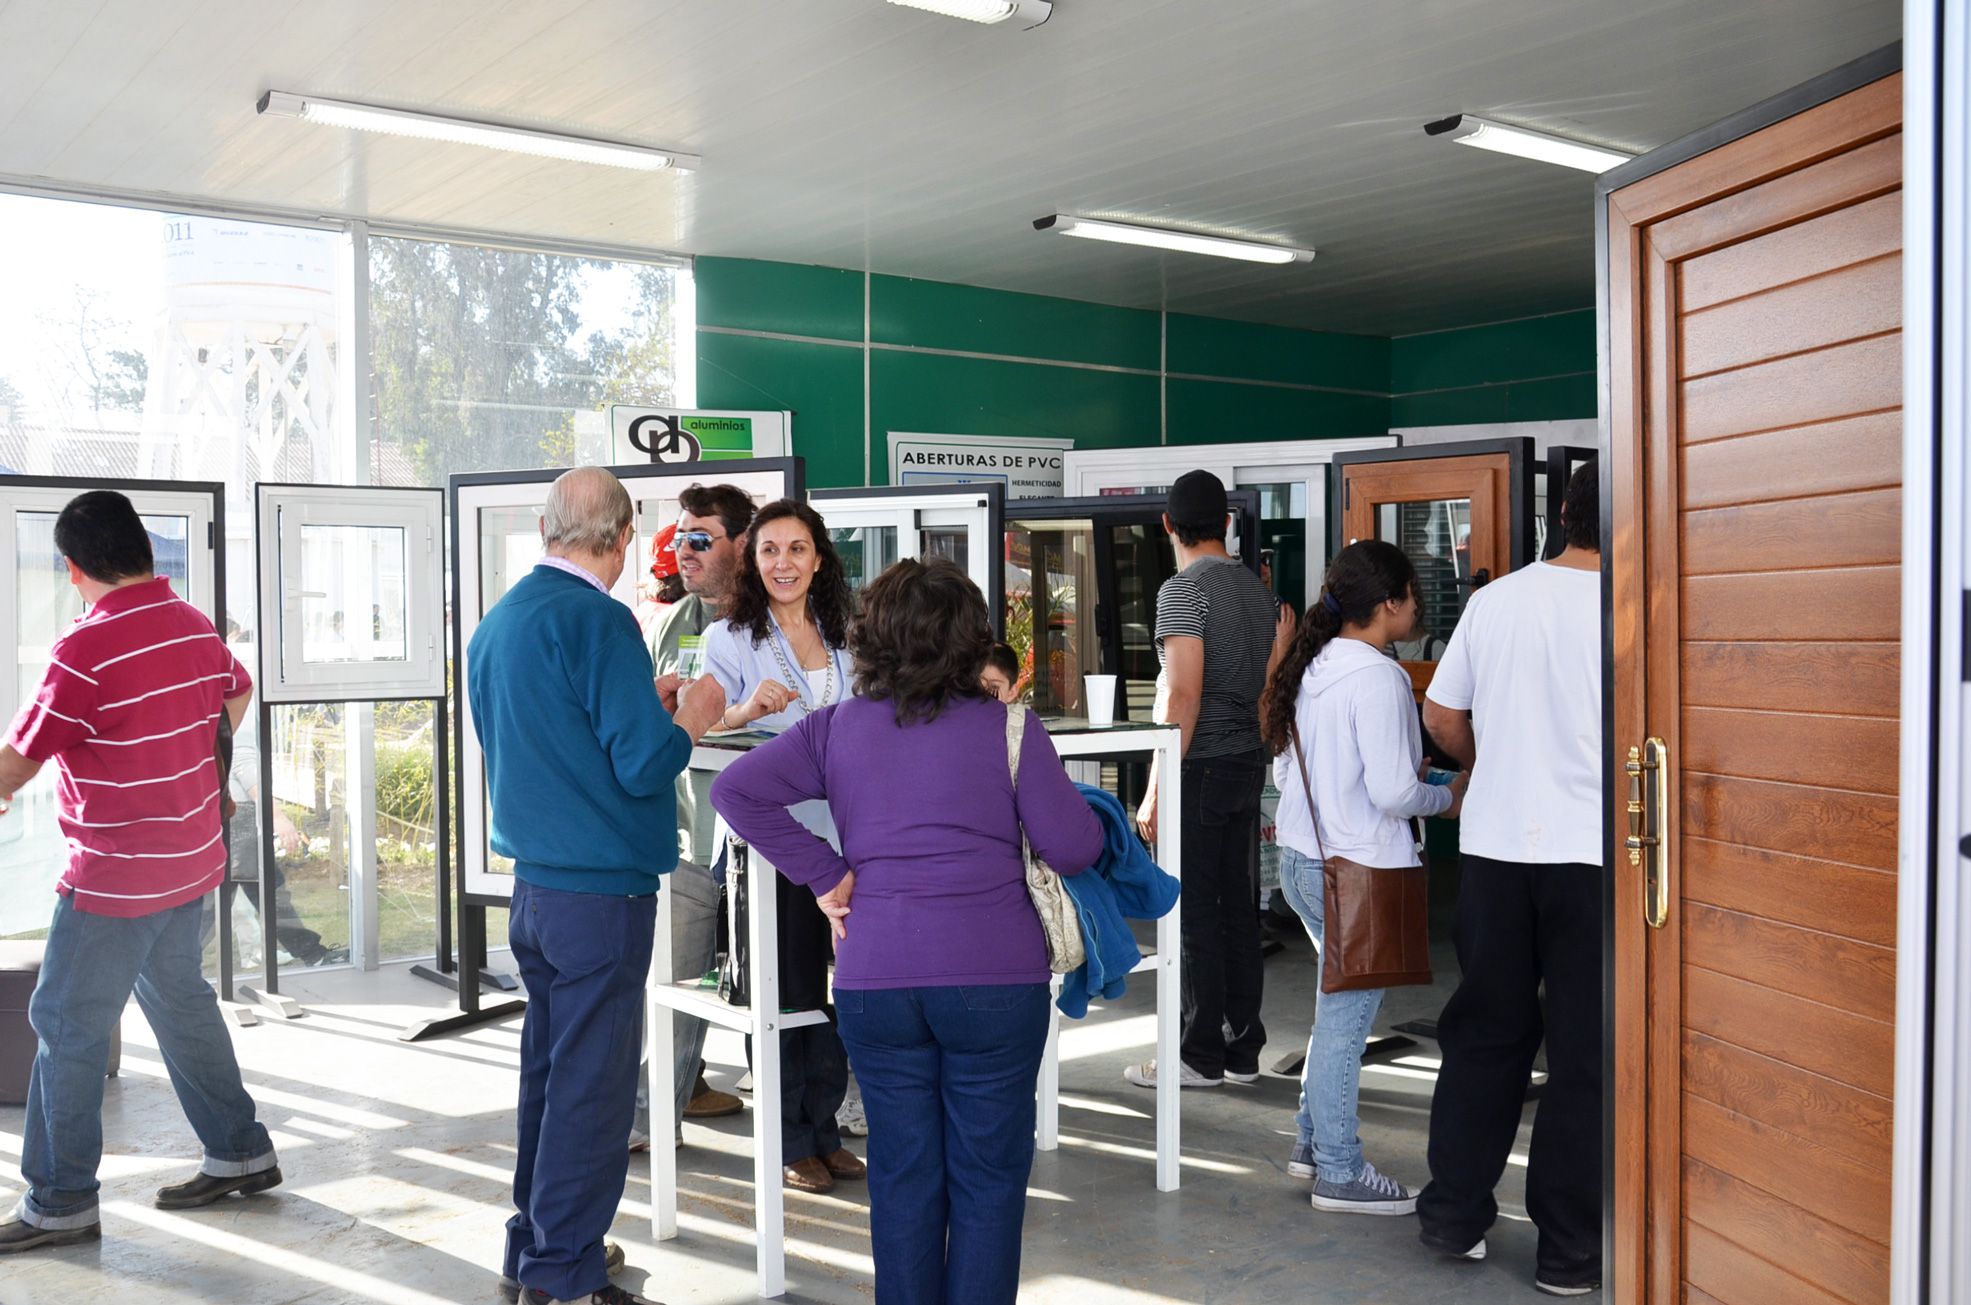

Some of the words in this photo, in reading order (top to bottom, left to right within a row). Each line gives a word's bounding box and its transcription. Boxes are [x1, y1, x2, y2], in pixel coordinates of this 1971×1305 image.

[161, 221, 195, 243] 011
[690, 419, 745, 431] aluminios
[902, 452, 997, 467] ABERTURAS
[1002, 455, 1023, 468] DE
[1028, 457, 1062, 469] PVC
[1011, 479, 1062, 488] HERMETICIDAD
